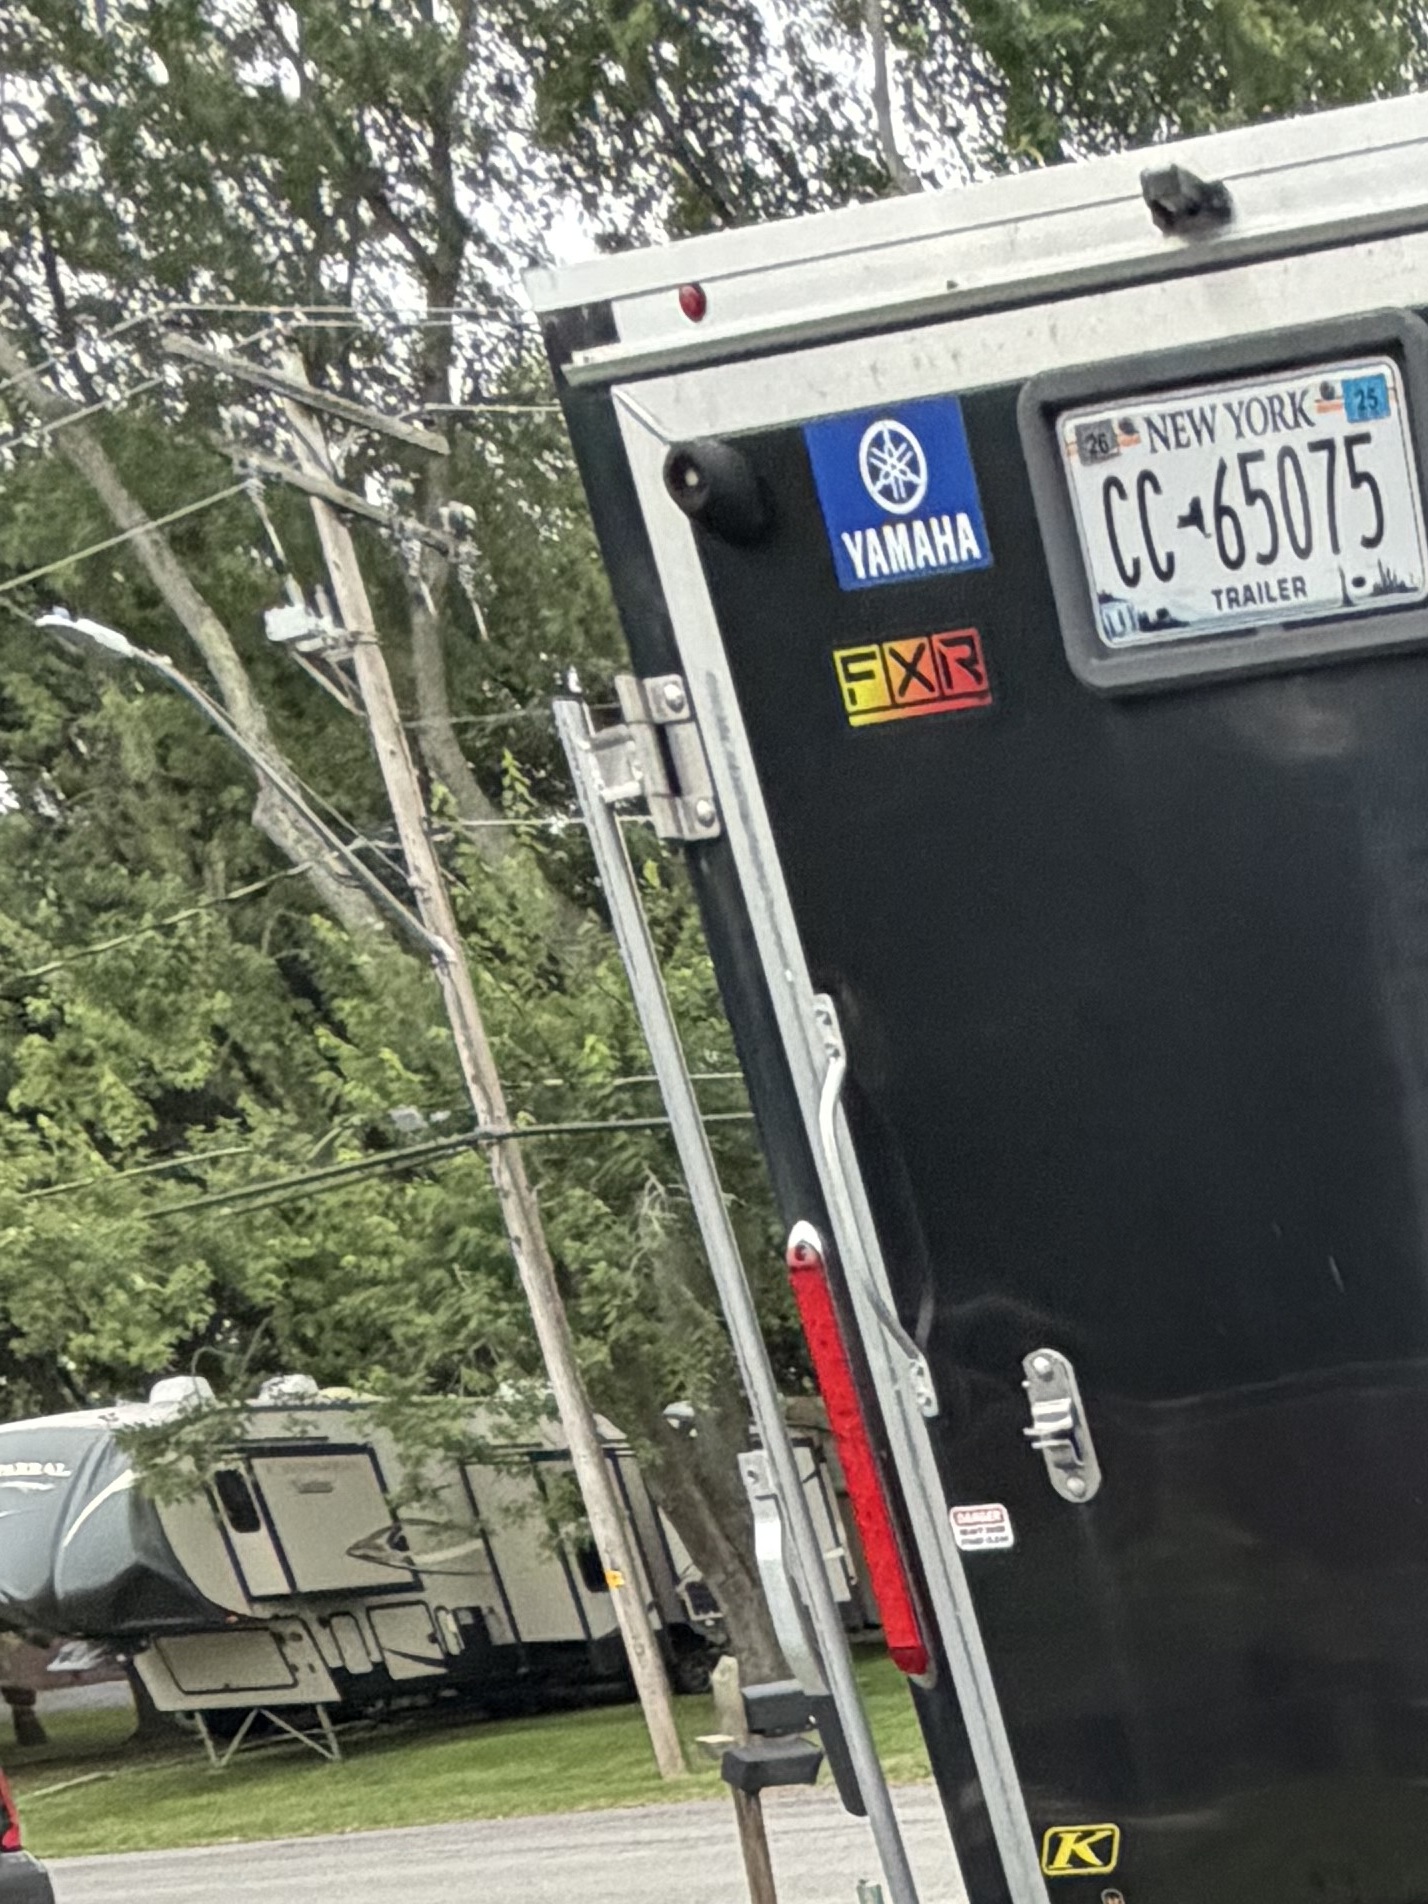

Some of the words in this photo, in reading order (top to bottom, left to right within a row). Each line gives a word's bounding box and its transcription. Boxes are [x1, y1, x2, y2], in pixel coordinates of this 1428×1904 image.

[1142, 401, 1221, 455] NEW
[1222, 389, 1317, 440] YORK
[1353, 387, 1379, 411] 25
[1084, 432, 1110, 455] 26
[1101, 468, 1176, 589] CC
[1212, 431, 1386, 572] 65075
[841, 512, 982, 580] YAMAHA
[1211, 575, 1309, 612] TRAILER
[838, 634, 986, 708] FXR
[1048, 1829, 1114, 1869] K
